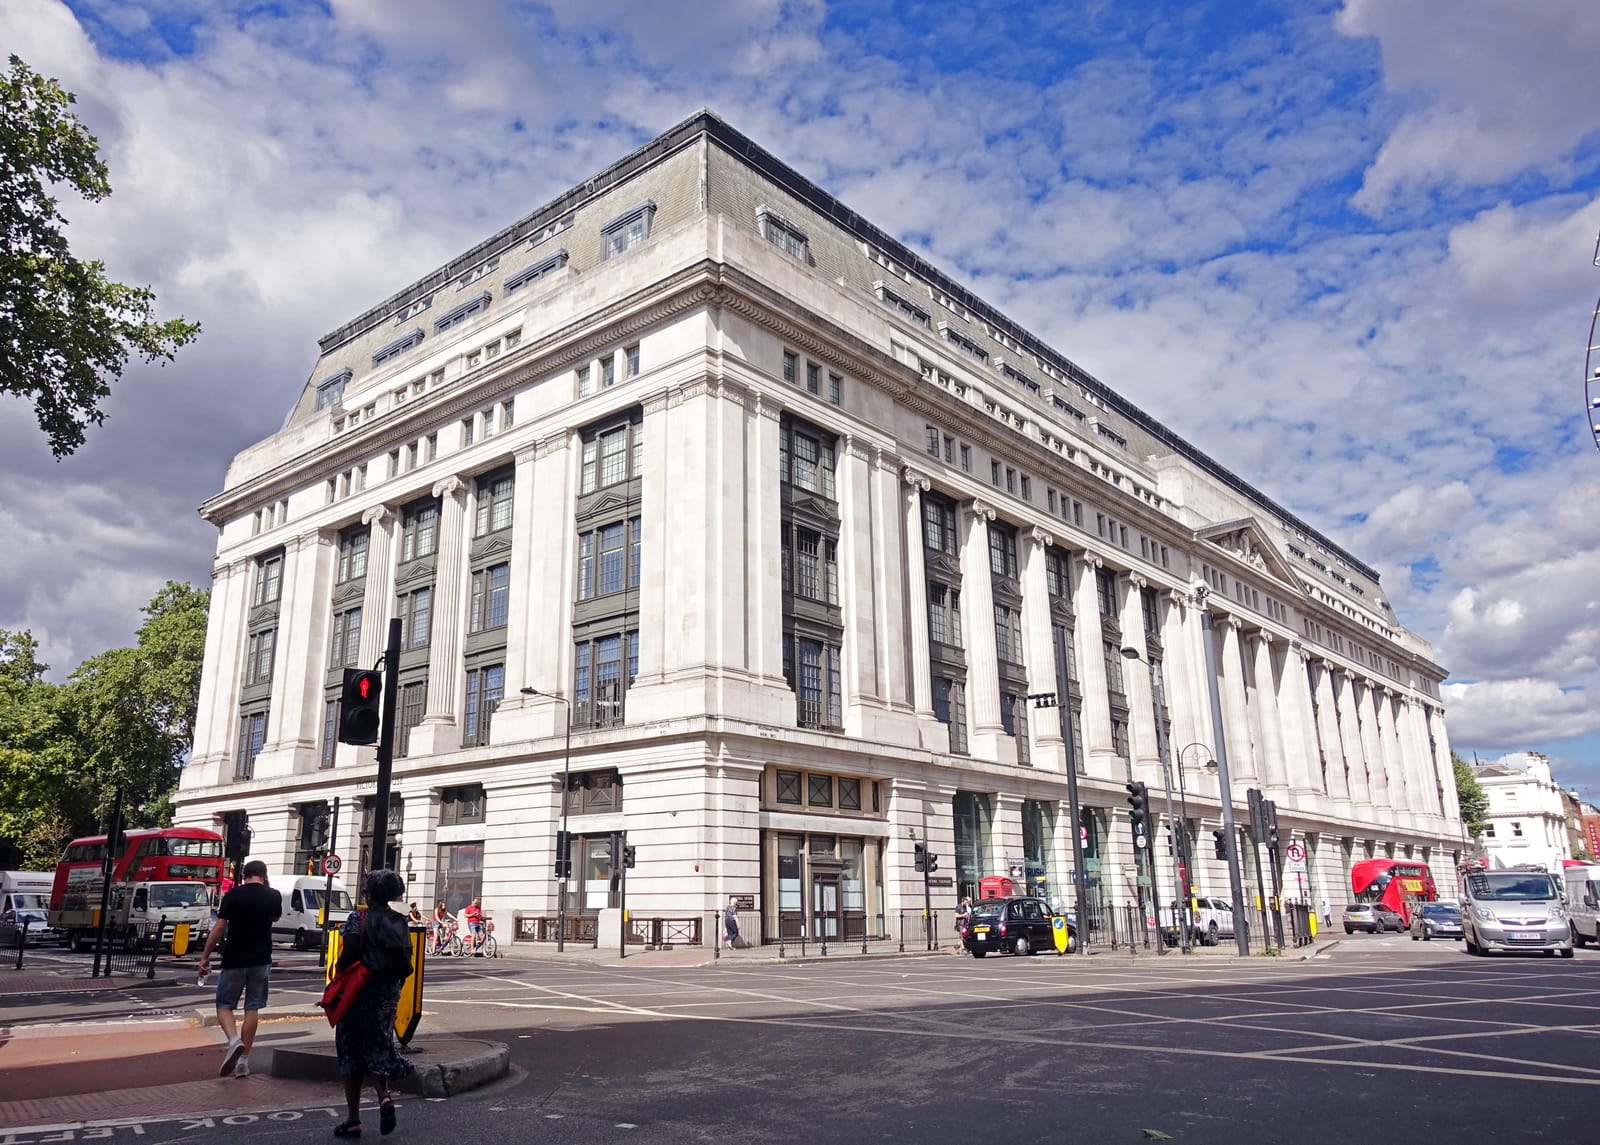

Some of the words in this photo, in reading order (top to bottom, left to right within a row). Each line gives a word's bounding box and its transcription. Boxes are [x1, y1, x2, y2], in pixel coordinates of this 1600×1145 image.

[326, 860, 340, 869] 20
[181, 1107, 339, 1130] LOOK
[0, 1124, 145, 1145] LEFT
